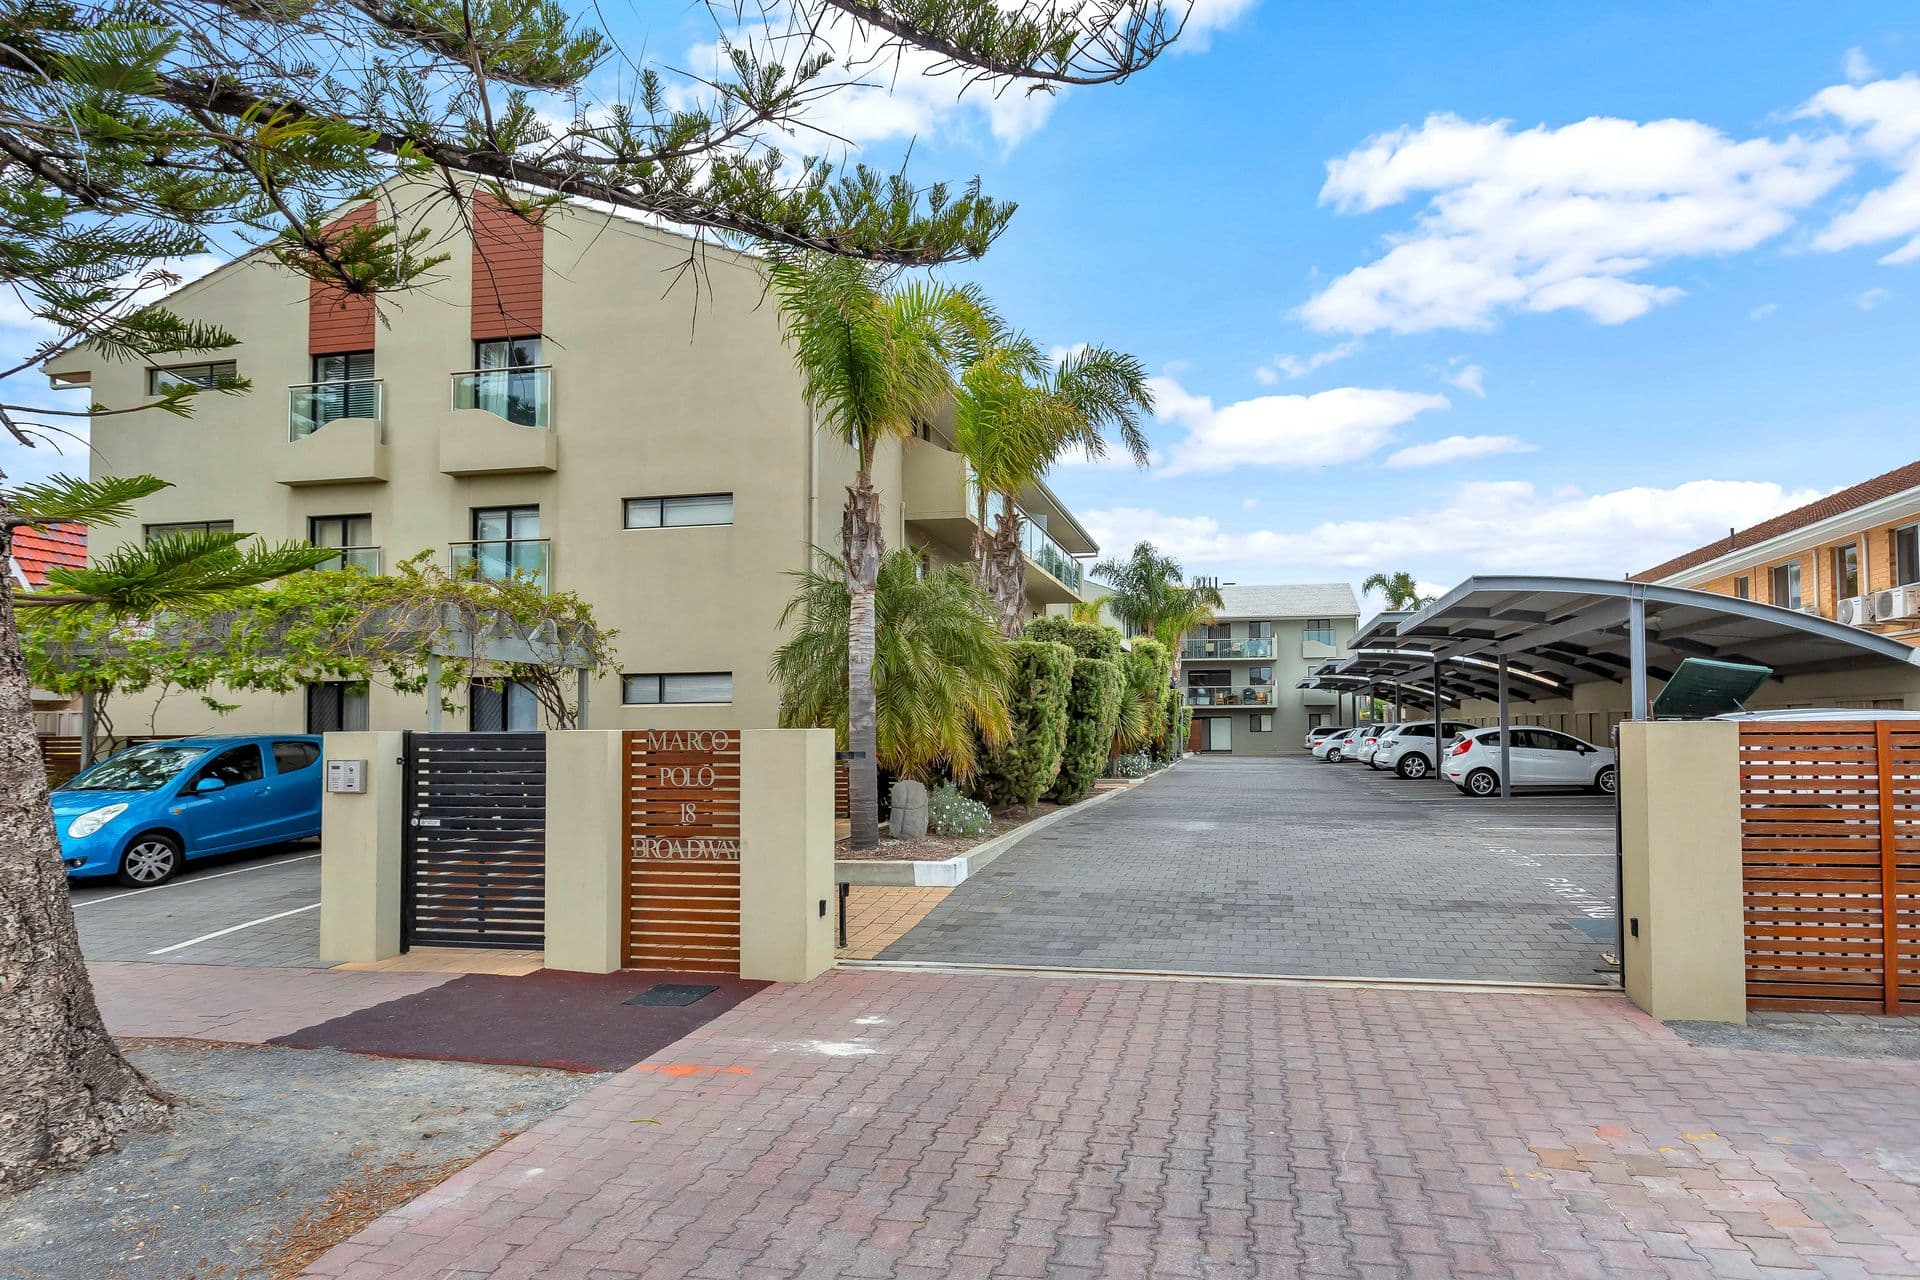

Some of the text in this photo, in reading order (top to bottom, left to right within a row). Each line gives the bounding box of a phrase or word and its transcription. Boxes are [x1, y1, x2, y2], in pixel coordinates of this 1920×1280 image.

[647, 731, 729, 751] MARCO
[659, 767, 716, 788] POLO
[680, 802, 697, 823] 18
